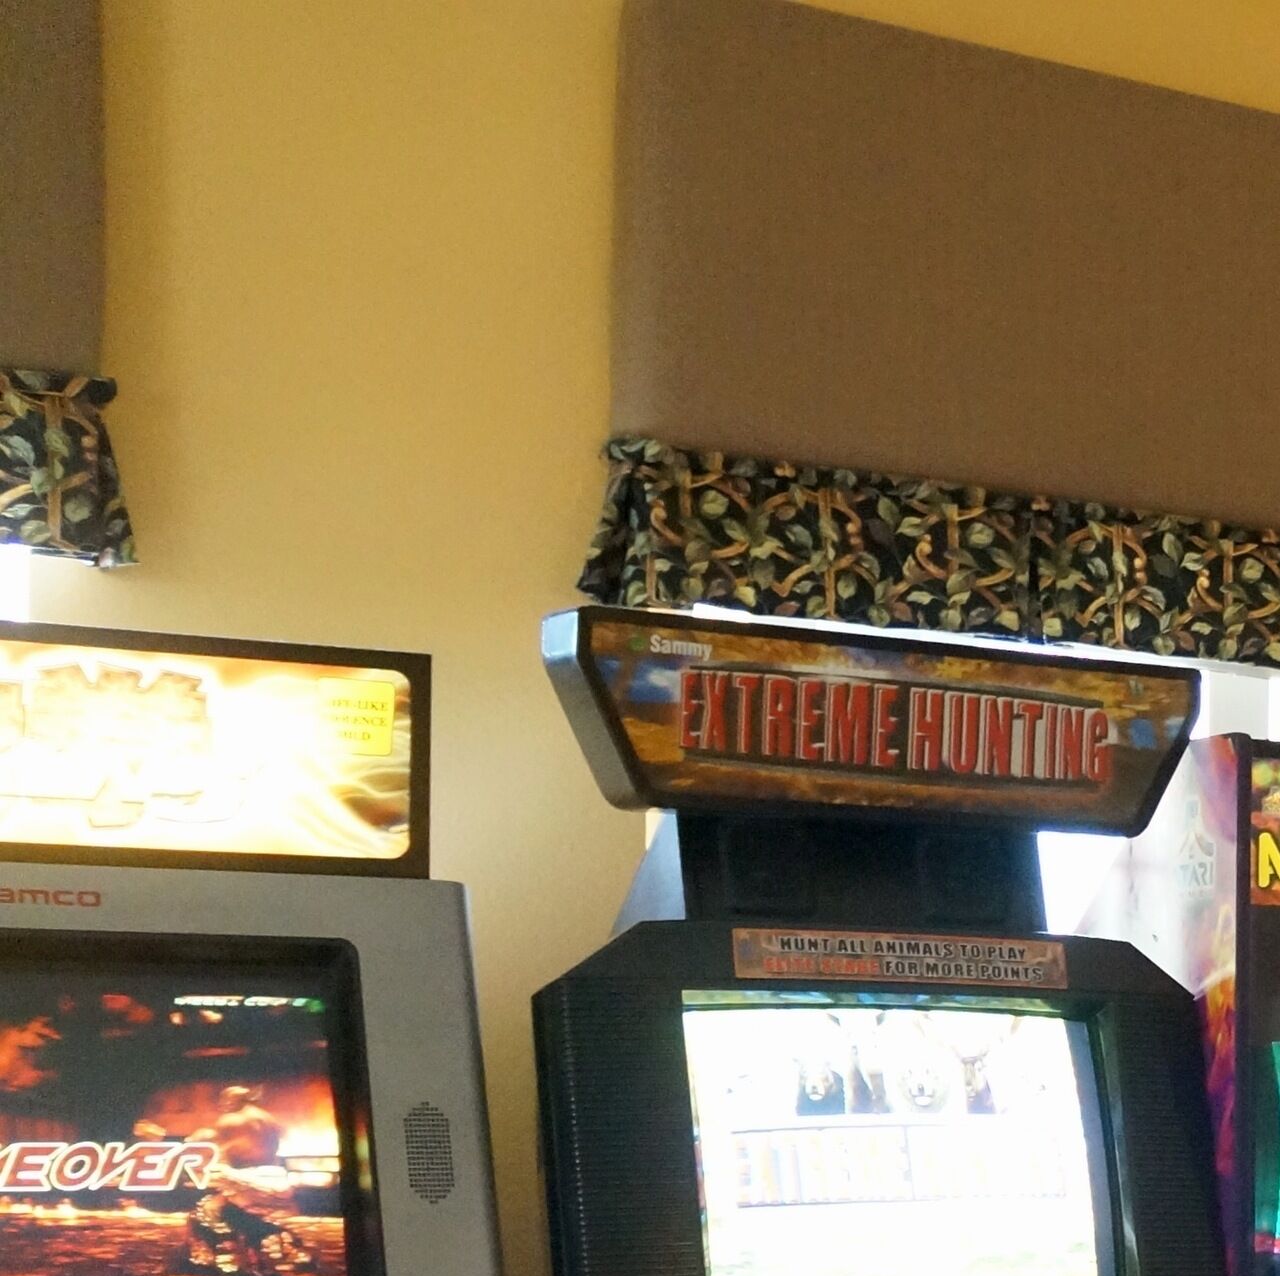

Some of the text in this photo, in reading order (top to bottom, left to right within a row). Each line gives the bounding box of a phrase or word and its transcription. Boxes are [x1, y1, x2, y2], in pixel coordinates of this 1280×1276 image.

[649, 633, 713, 662] Sammy
[680, 668, 1114, 782] EXTREME HUNTING
[1174, 861, 1214, 887] TARI
[0, 887, 102, 908] amco
[779, 936, 1027, 961] HUNT ALL ANIMALS TO PLAY
[883, 960, 919, 976] FOR
[924, 961, 976, 978] MORE
[980, 963, 1044, 982] POINTS
[0, 1141, 221, 1192] EOVER
